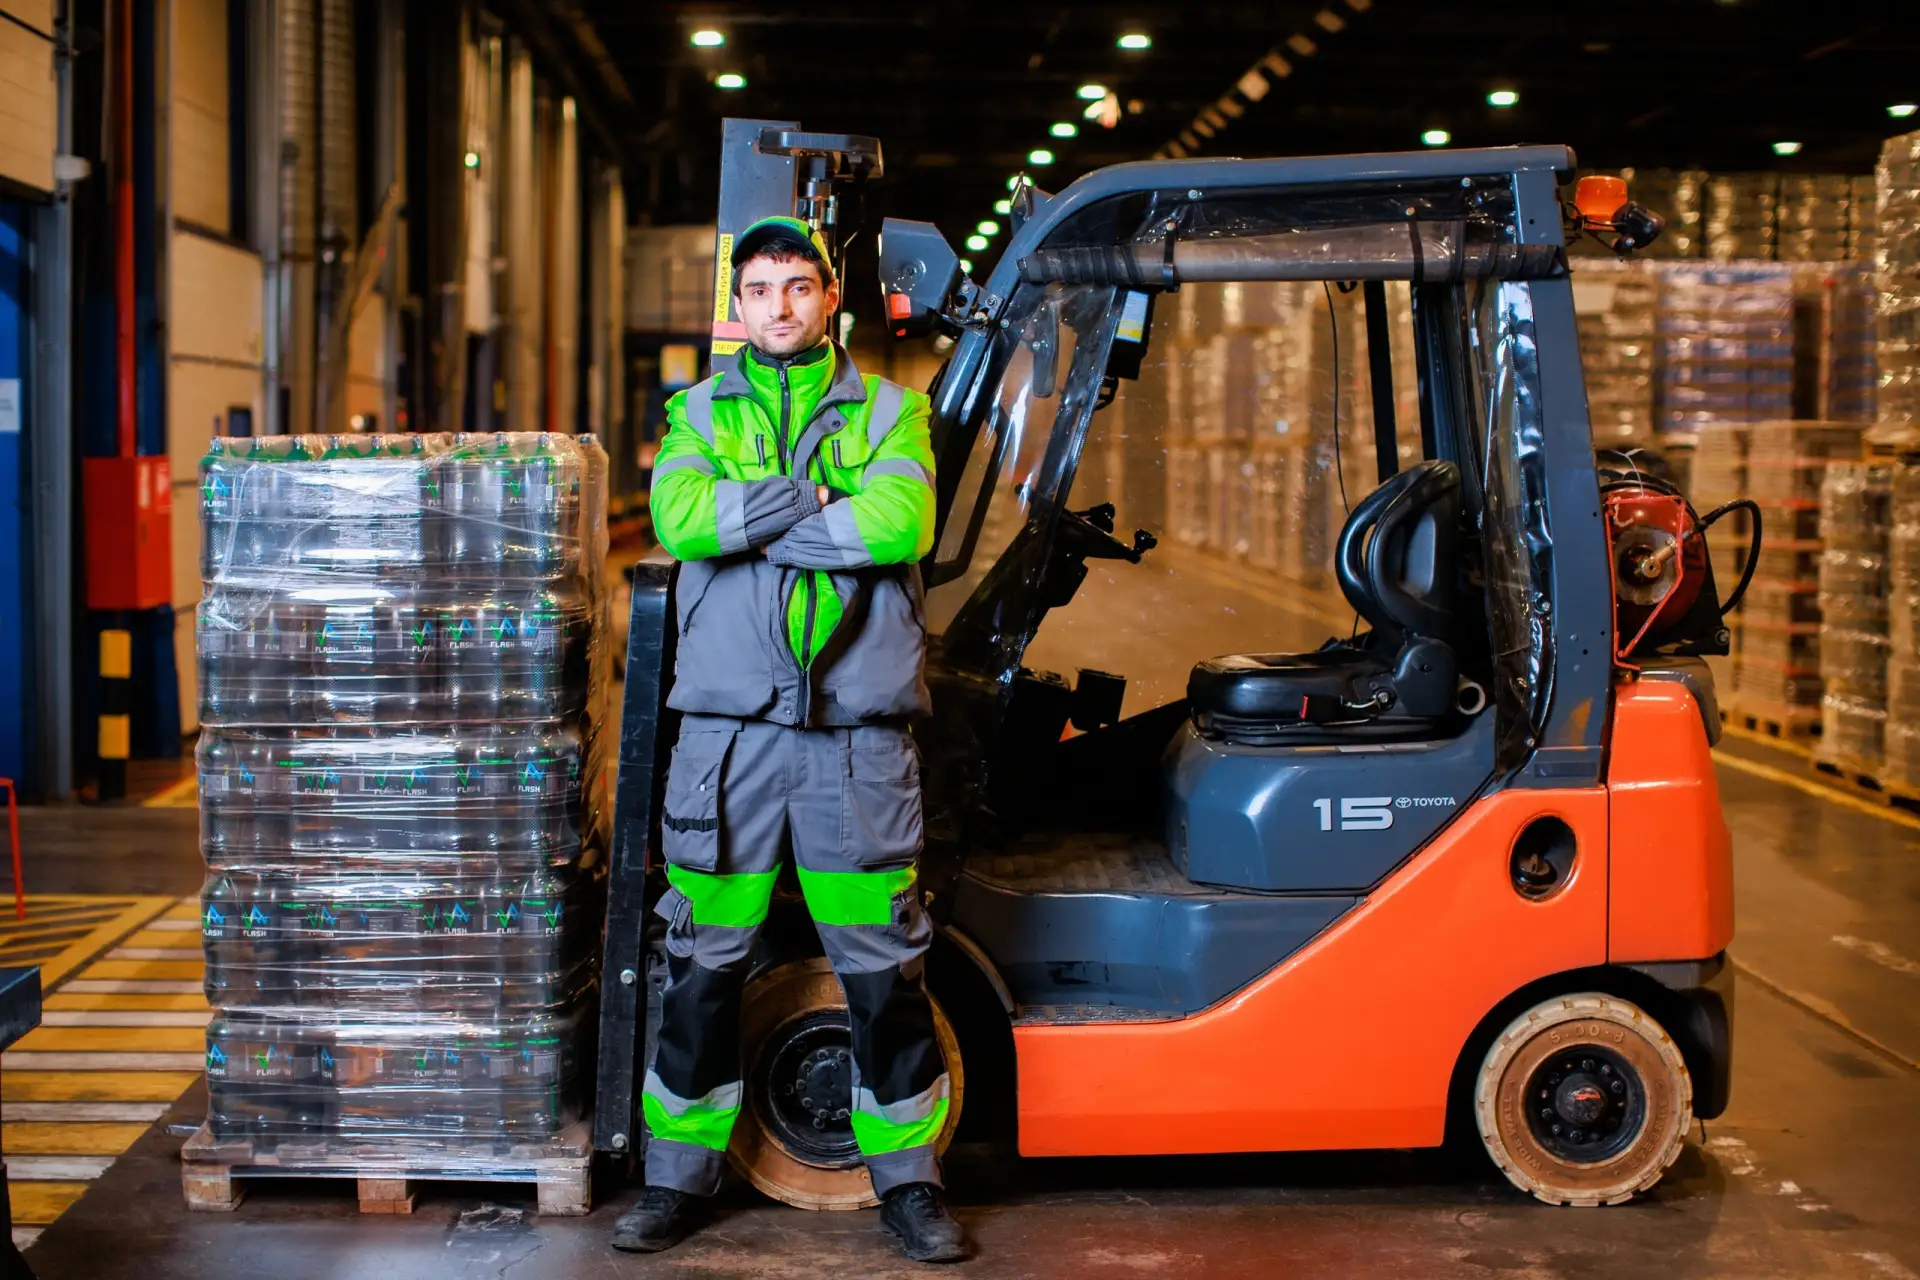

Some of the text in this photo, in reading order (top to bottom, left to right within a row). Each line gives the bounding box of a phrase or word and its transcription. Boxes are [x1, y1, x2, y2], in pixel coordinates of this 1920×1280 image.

[721, 236, 731, 263] ХОД
[1313, 796, 1456, 831] 15 TOYOTA
